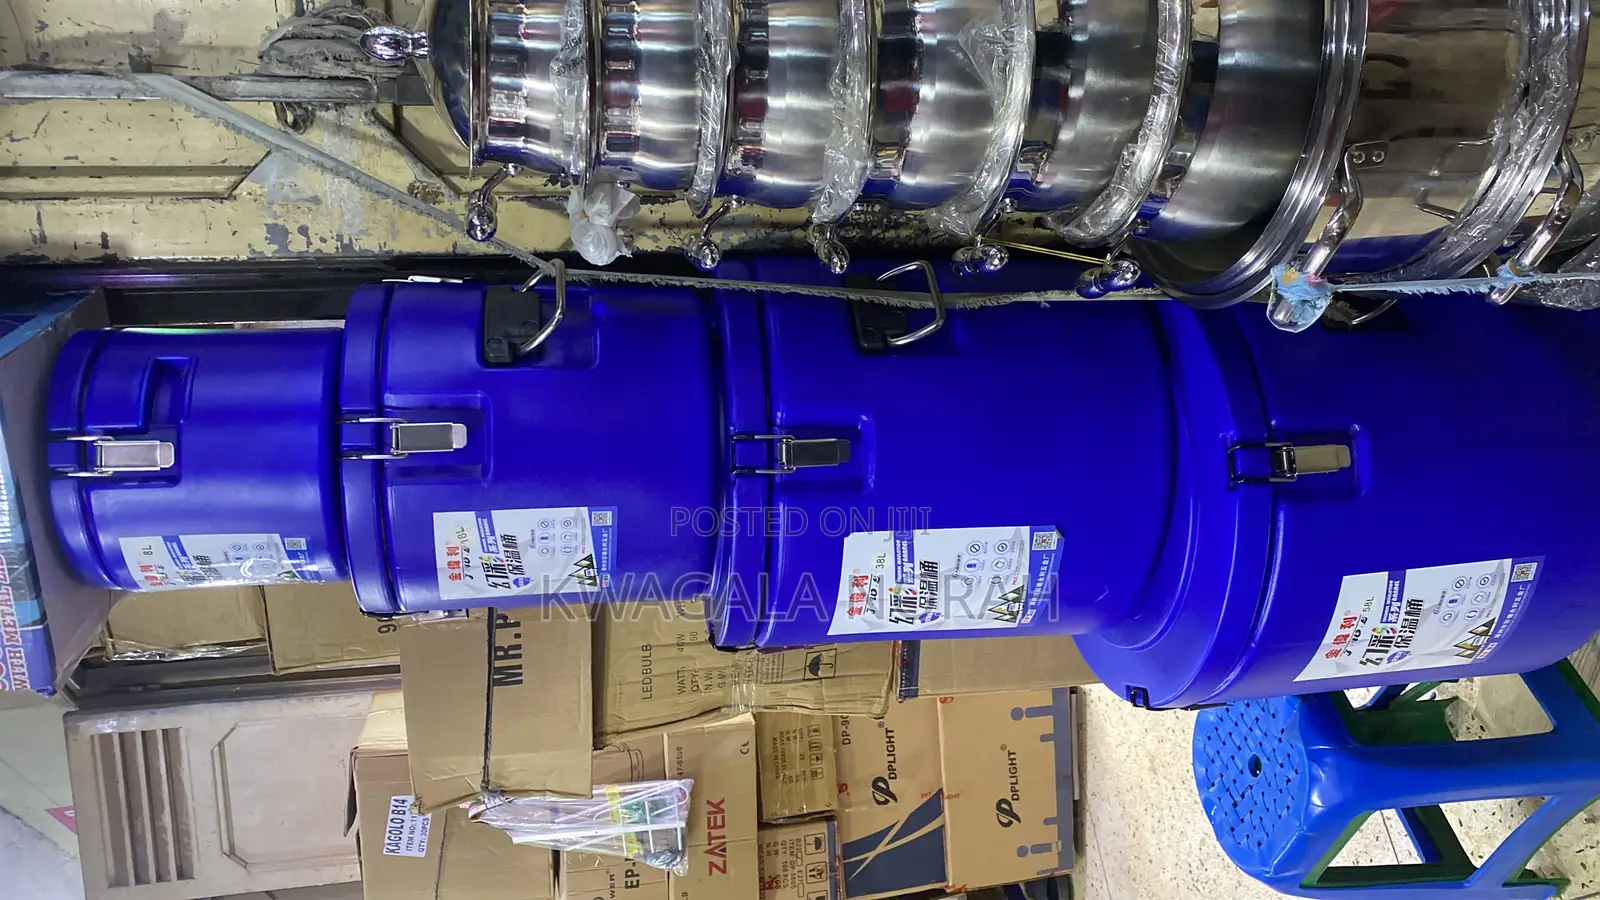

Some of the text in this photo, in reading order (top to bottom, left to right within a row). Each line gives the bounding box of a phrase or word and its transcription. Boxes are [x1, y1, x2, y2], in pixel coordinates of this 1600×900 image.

[142, 544, 153, 556] 8L
[456, 526, 469, 544] 18L
[500, 534, 525, 576] 保温桶
[875, 553, 887, 569] 38L
[903, 562, 914, 584] 系列
[919, 559, 939, 610] 保温桶
[1362, 596, 1374, 612] 58L
[0, 588, 19, 644] METAL
[888, 586, 918, 624] 幻彩
[1388, 602, 1401, 622] 系列
[1394, 598, 1424, 649] 保温桶
[1359, 626, 1397, 666] 幻彩
[7, 648, 29, 690] WITH
[886, 728, 897, 780] DPLIGHT
[1008, 750, 1020, 801] DPLIGHT
[385, 798, 408, 854] KAGOLO B14
[406, 837, 414, 852] ITEM
[418, 838, 426, 852] QTY:
[703, 797, 727, 876] ZATEK
